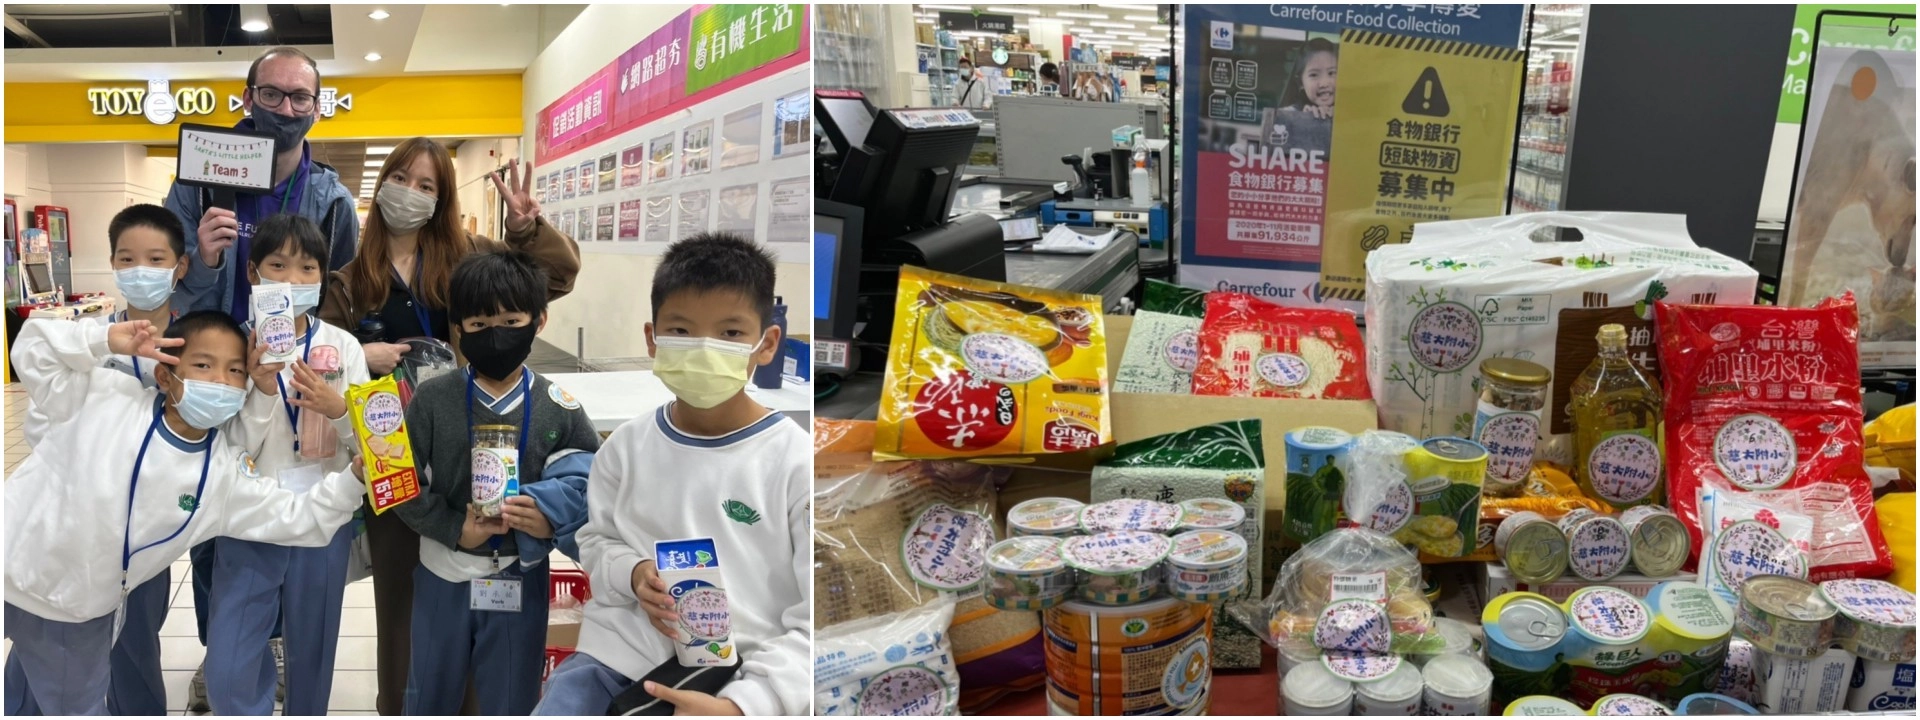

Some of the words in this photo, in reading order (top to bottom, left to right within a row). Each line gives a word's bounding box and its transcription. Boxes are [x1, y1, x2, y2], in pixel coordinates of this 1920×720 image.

[1270, 4, 1342, 24] Carrefour
[1346, 10, 1384, 28] Food
[1387, 15, 1460, 36] Collection
[711, 4, 793, 64] 有機生活
[629, 37, 681, 91] 網路超夯
[552, 89, 603, 139] 促銷活動資訊
[1386, 118, 1461, 144] 食物銀行
[1229, 143, 1325, 174] SHARE
[1384, 145, 1456, 170] 短缺物資
[212, 163, 238, 177] Team
[241, 167, 249, 179] 3
[1228, 171, 1324, 194] 食物銀行募集
[1378, 171, 1455, 202] 募集中
[1217, 280, 1296, 299] Carrefour
[1760, 319, 1819, 339] 台灣
[1728, 447, 1783, 463] 慈大附小
[402, 470, 417, 497] EXTRA
[1600, 461, 1651, 480] 慈大附小
[375, 479, 393, 506] 15%
[686, 611, 730, 622] 慈大附小
